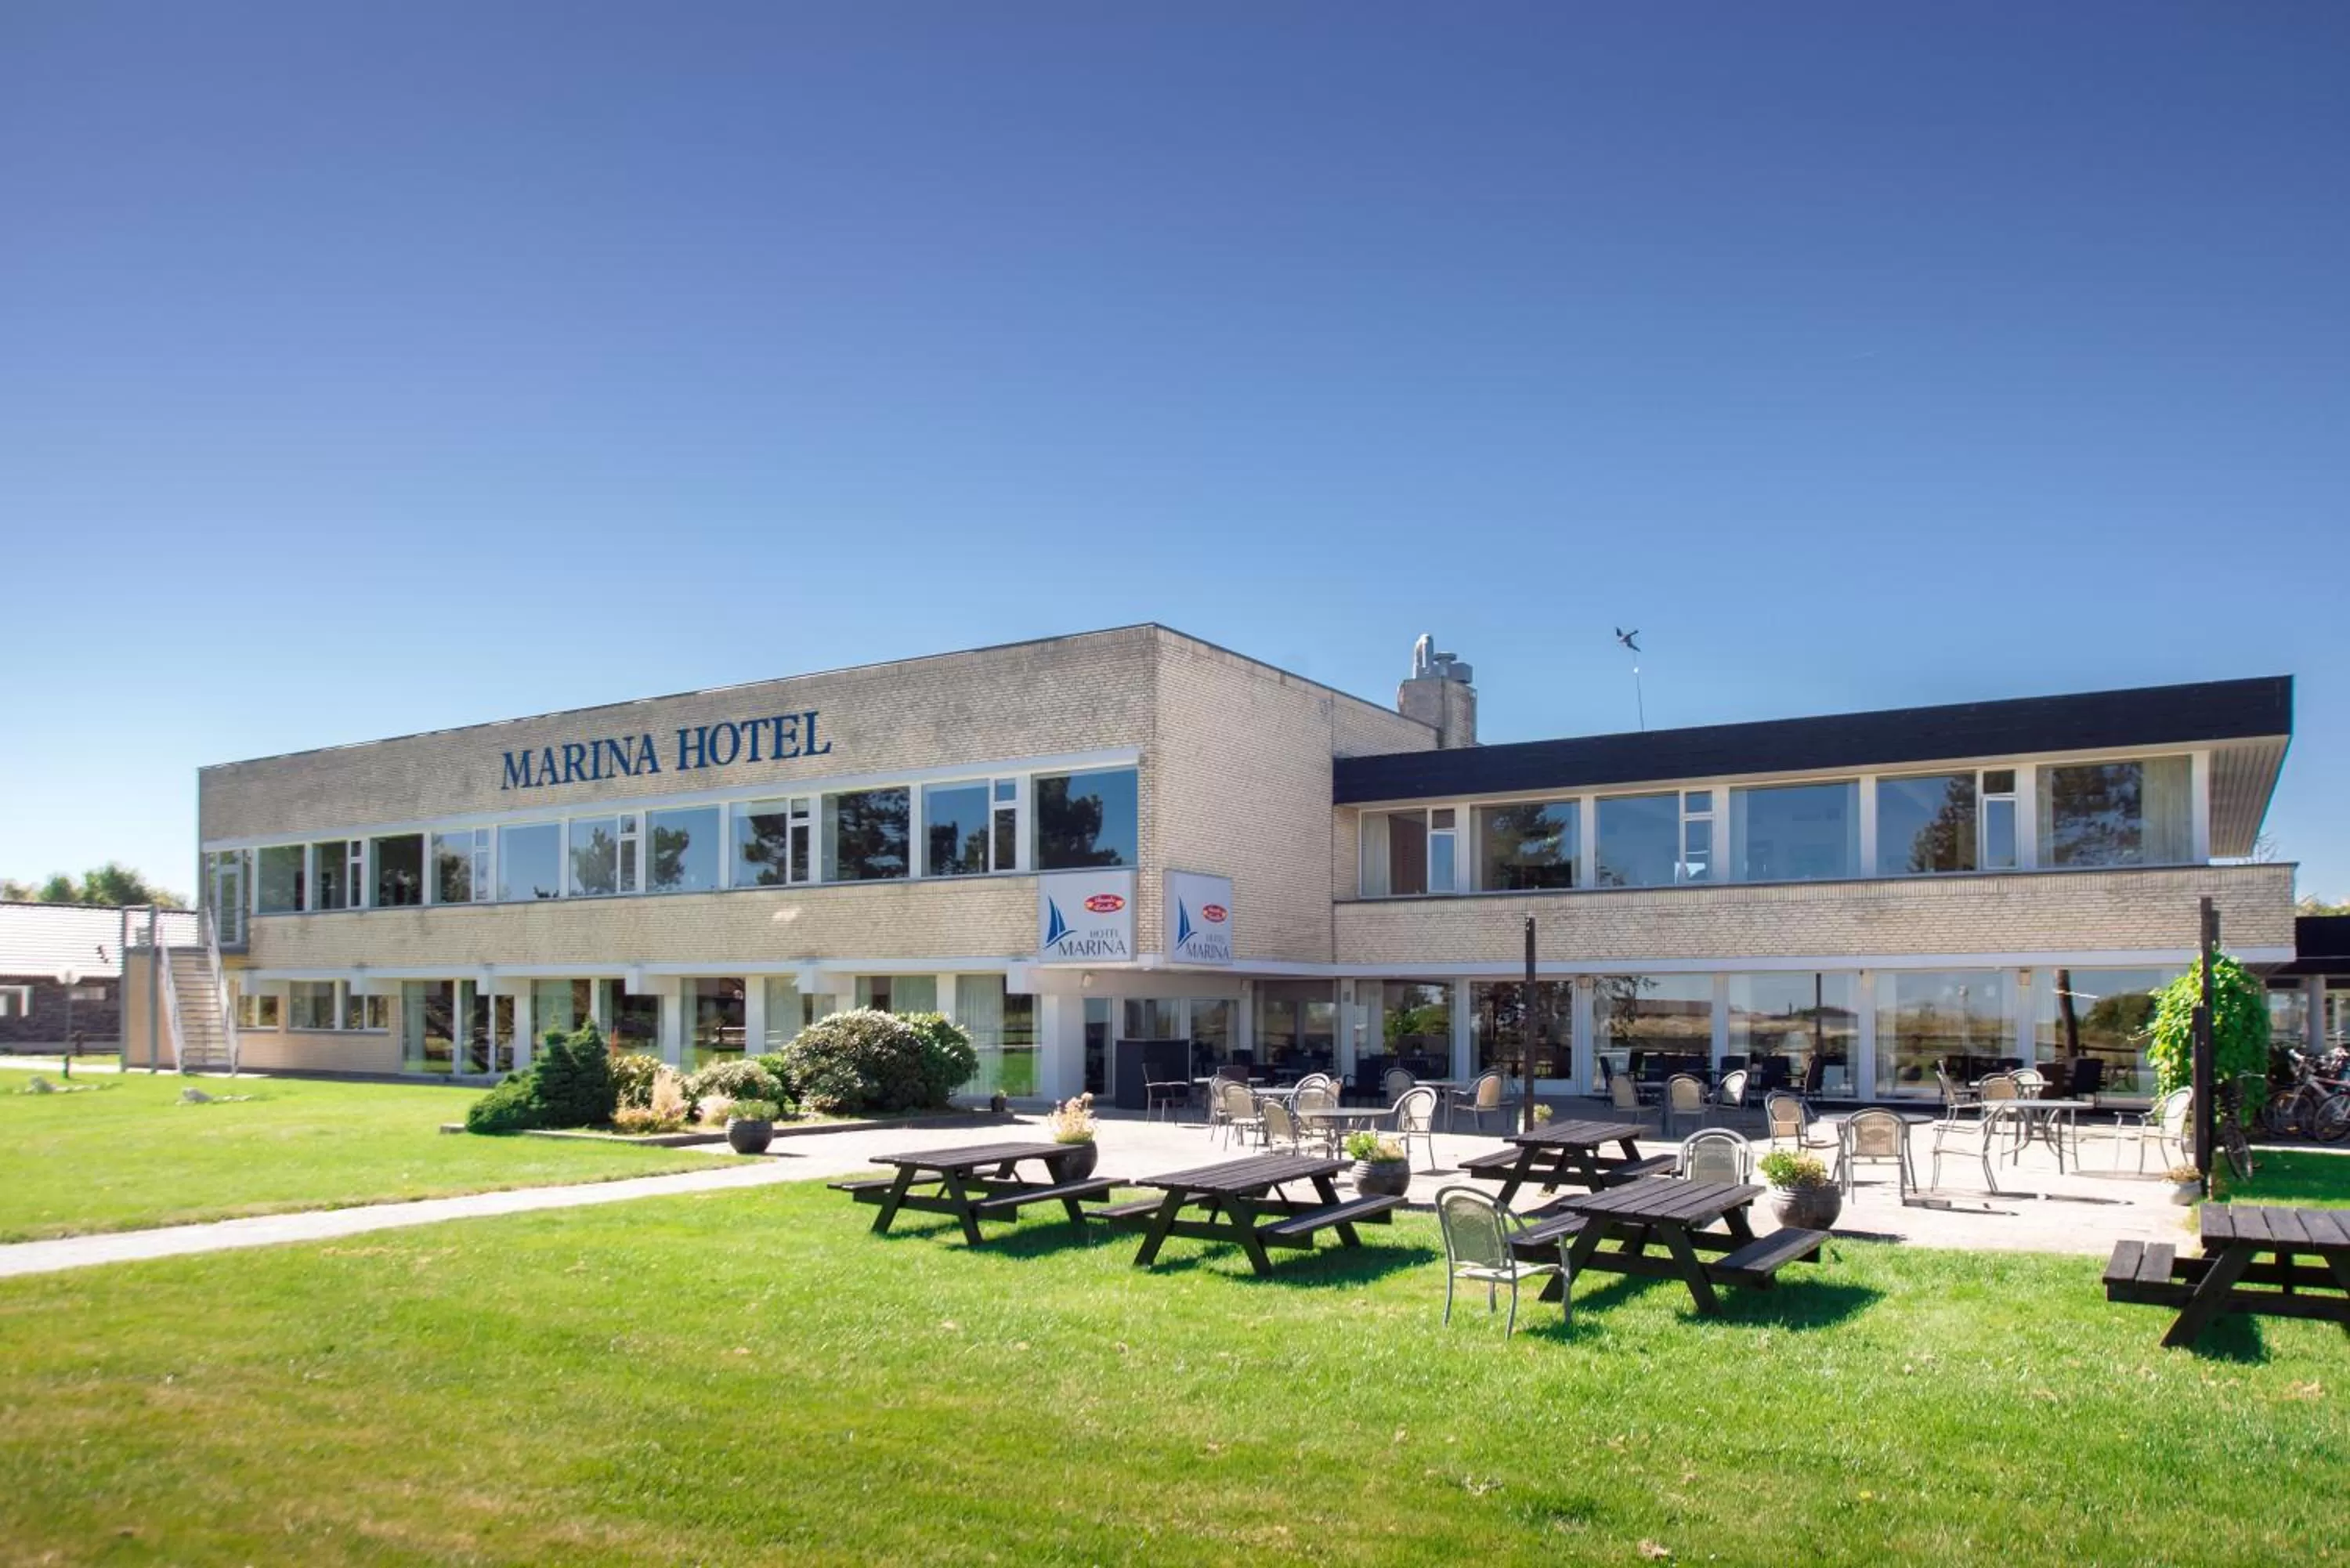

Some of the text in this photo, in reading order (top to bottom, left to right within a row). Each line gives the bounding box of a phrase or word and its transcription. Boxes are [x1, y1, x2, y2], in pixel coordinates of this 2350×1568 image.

[501, 711, 832, 790] MARINA HOTEL
[1090, 929, 1119, 938] HOTEL
[1058, 939, 1126, 956] MARINA
[1186, 942, 1230, 960] MARINA
